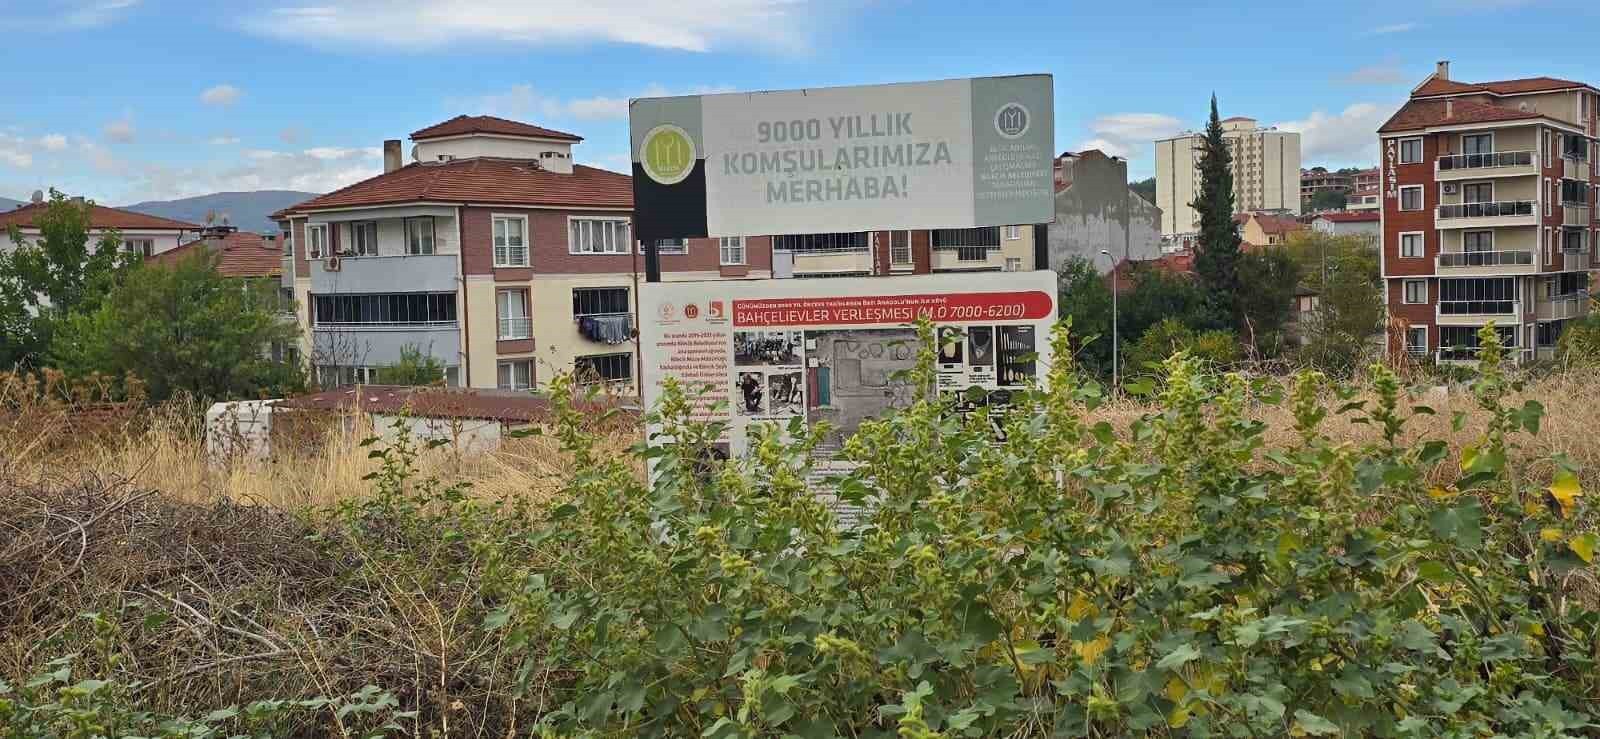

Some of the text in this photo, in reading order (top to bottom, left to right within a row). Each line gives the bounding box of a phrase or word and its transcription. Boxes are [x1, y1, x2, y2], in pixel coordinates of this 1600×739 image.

[757, 111, 913, 143] 9000 YILLIK
[723, 141, 953, 178] KOMŞULARIMIZA
[766, 174, 909, 204] MERHABA!
[737, 309, 829, 325] BAHÇELİEVLER
[833, 306, 913, 323] YERLEŞMESİ
[950, 303, 1025, 319] 7000-6200)
